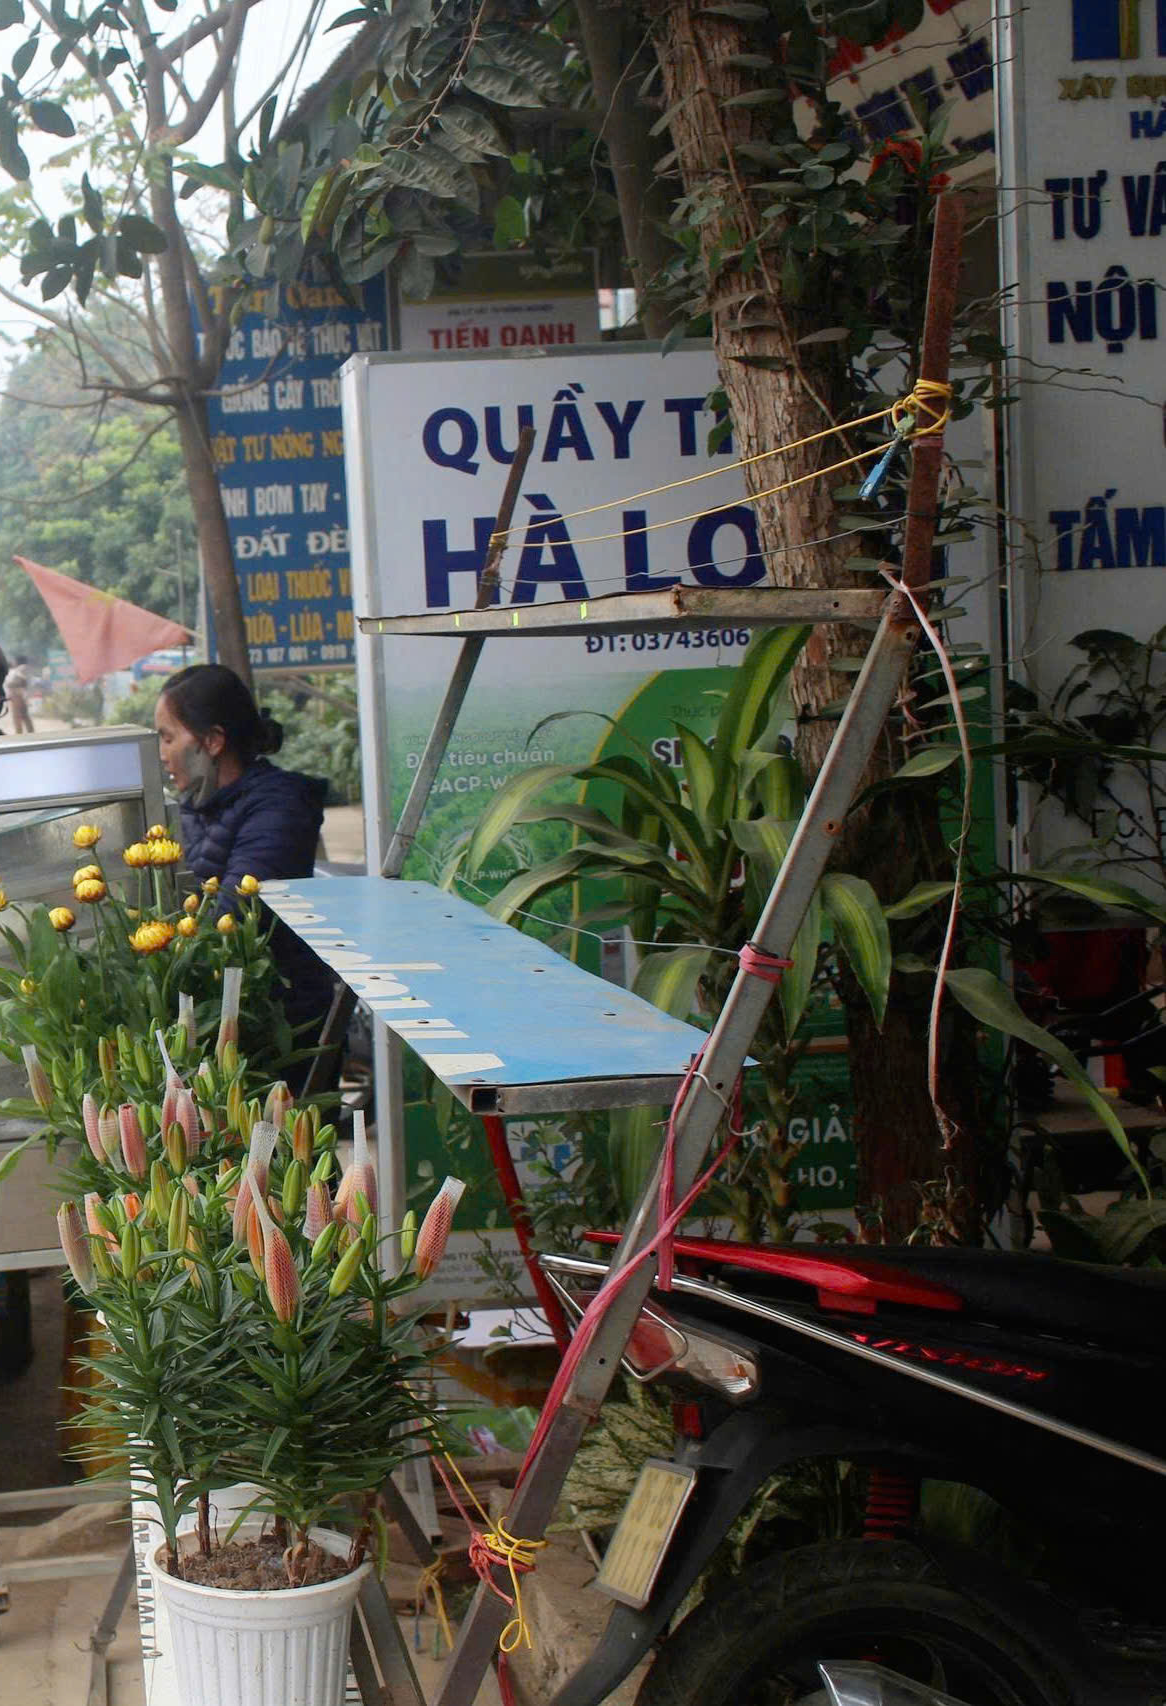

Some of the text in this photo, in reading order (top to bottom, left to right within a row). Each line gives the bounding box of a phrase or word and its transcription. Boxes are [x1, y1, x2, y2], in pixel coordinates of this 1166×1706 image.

[1045, 169, 1108, 240] TƯ
[1046, 265, 1158, 354] NỘI
[428, 318, 577, 351] TIẾN OANH
[274, 375, 305, 411] CÂY
[270, 427, 315, 460] NÔNG
[422, 382, 646, 476] QUẦY
[254, 482, 294, 517] BƠM
[300, 482, 329, 513] TAY
[236, 524, 291, 560] ĐẤT
[1049, 489, 1166, 571] TẤM
[422, 493, 769, 608] HÀ LO
[585, 628, 751, 654] ĐT: 03743606
[448, 743, 555, 767] tiêu chuẩn
[788, 1103, 853, 1145] GIẢ
